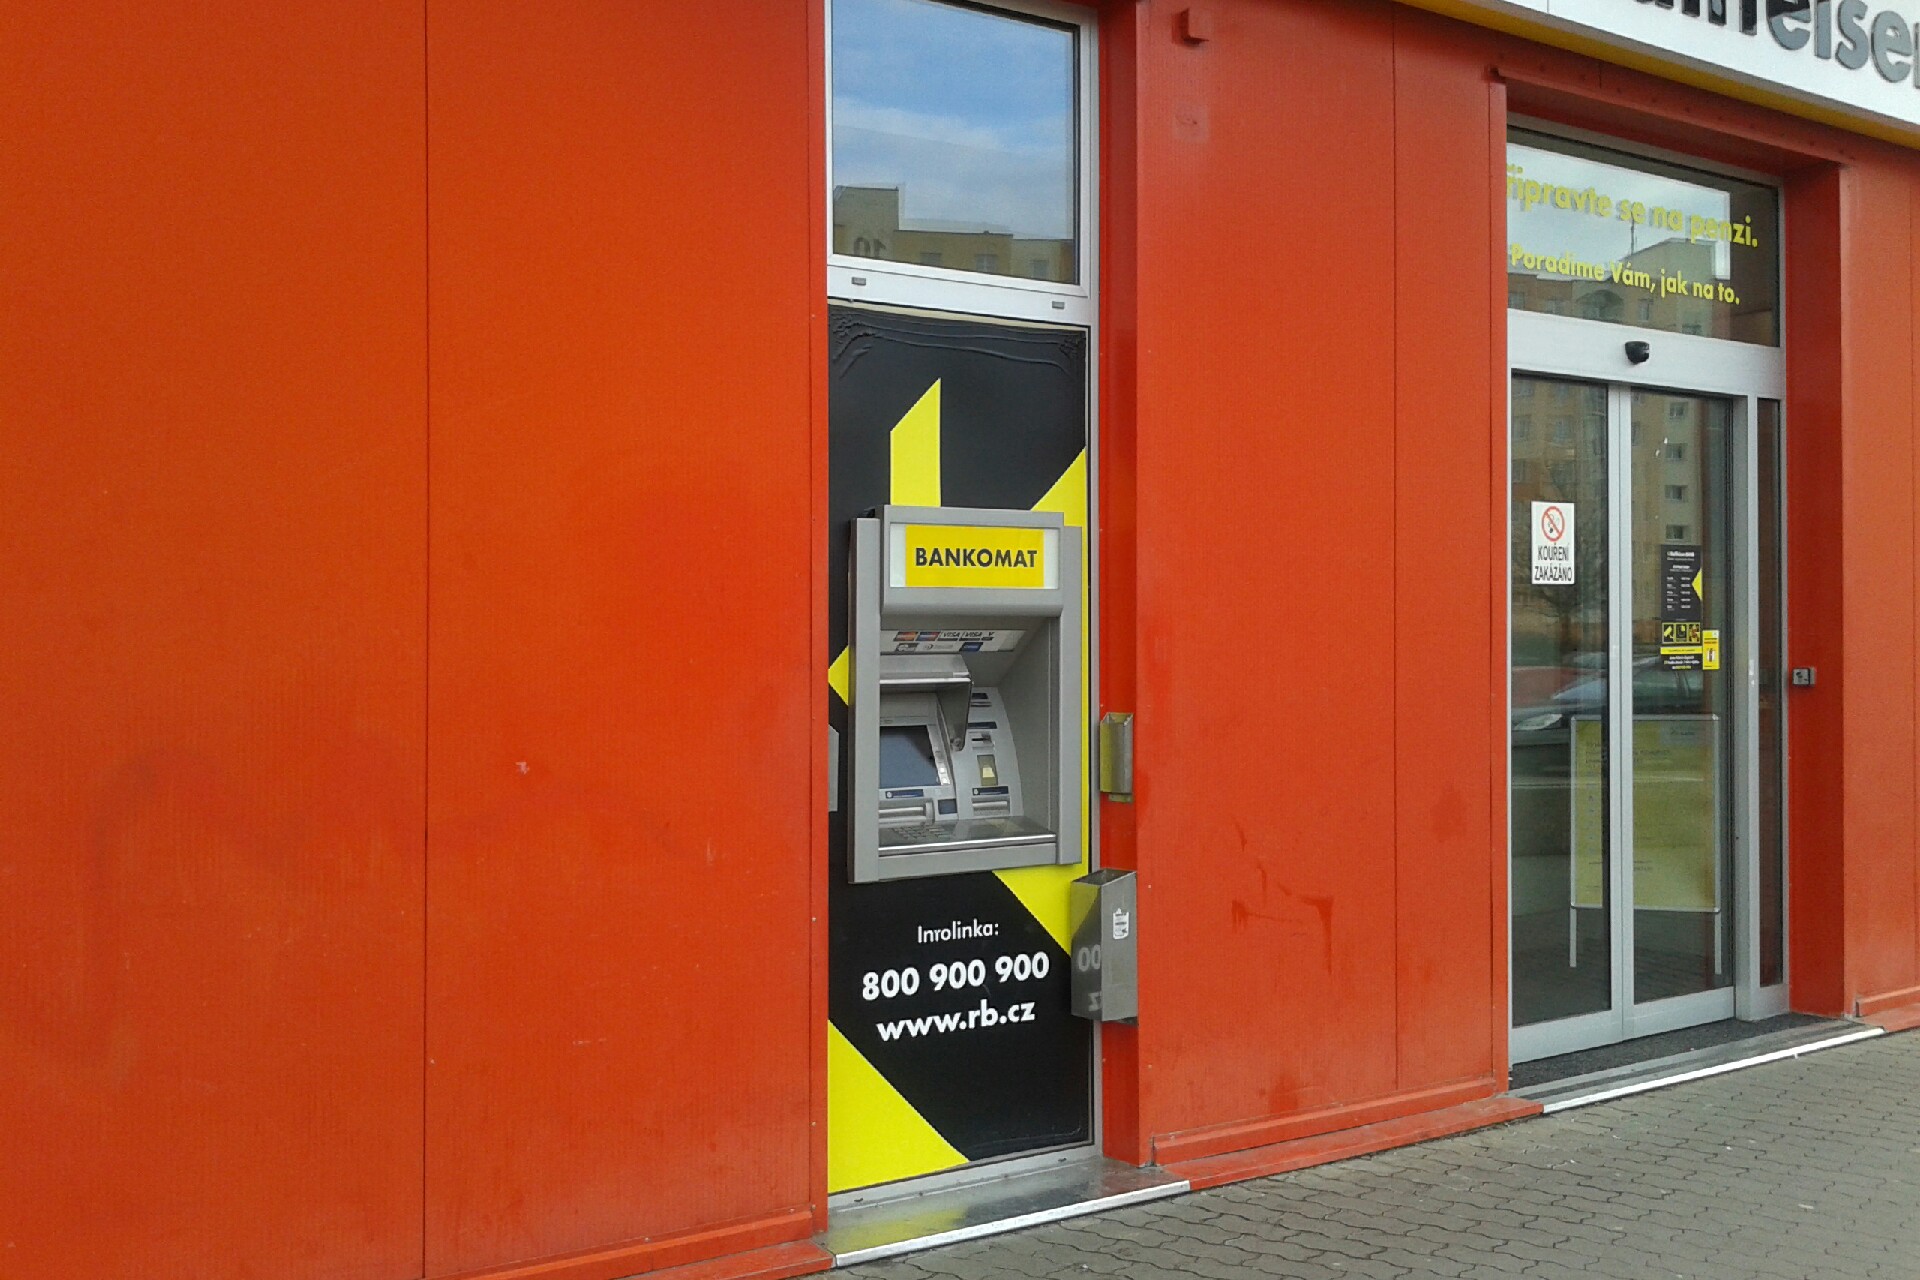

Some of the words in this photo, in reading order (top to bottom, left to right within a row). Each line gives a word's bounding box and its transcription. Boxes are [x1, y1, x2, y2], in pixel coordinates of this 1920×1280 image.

[1619, 199, 1645, 225] se
[1653, 206, 1683, 232] na
[1690, 215, 1758, 247] penzi.
[1610, 260, 1656, 293] Vám,
[1660, 268, 1688, 298] jak
[1693, 281, 1714, 300] na
[1718, 282, 1740, 305] to.
[915, 547, 1037, 567] BANKOMAT
[1534, 563, 1573, 582] ZAKÁZÁNO
[1537, 542, 1570, 561] KOUŘENÍ
[862, 967, 920, 1001] 800
[929, 959, 986, 992] 900
[994, 951, 1050, 983] 900
[876, 999, 1036, 1042] www.rb.cz
